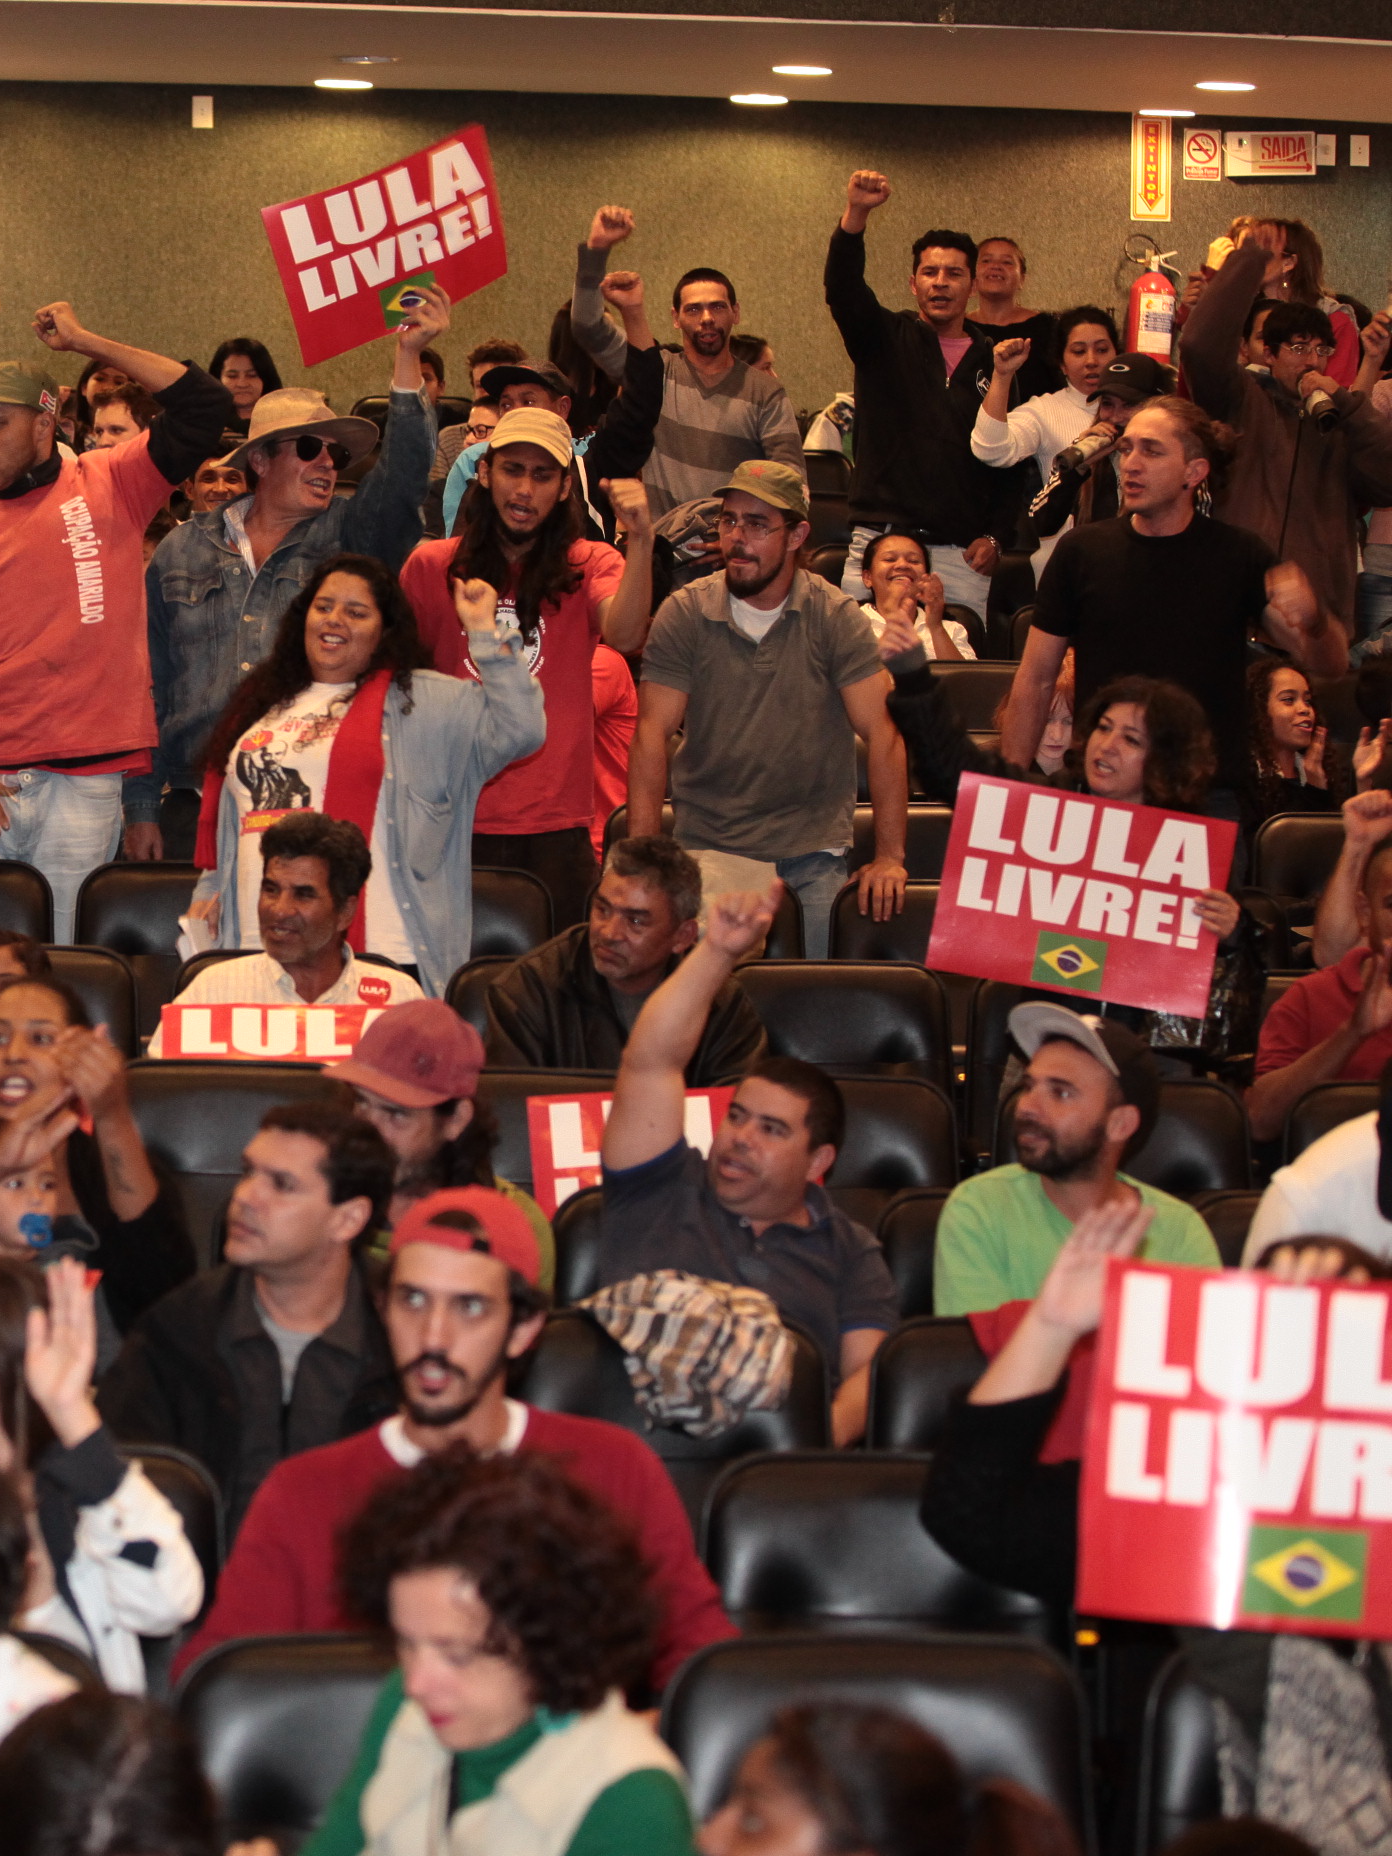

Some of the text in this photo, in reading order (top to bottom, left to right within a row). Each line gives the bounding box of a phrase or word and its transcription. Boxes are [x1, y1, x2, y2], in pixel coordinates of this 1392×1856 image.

[279, 141, 486, 265] LULA
[1146, 127, 1157, 200] EXTINTOR
[297, 194, 493, 313] LIVRE!
[74, 560, 105, 624] AMARILDO
[967, 783, 1210, 891] LULA
[955, 855, 1204, 950] LIVRE!
[1113, 1269, 1392, 1413] LUL
[1105, 1400, 1392, 1523] LIVR
